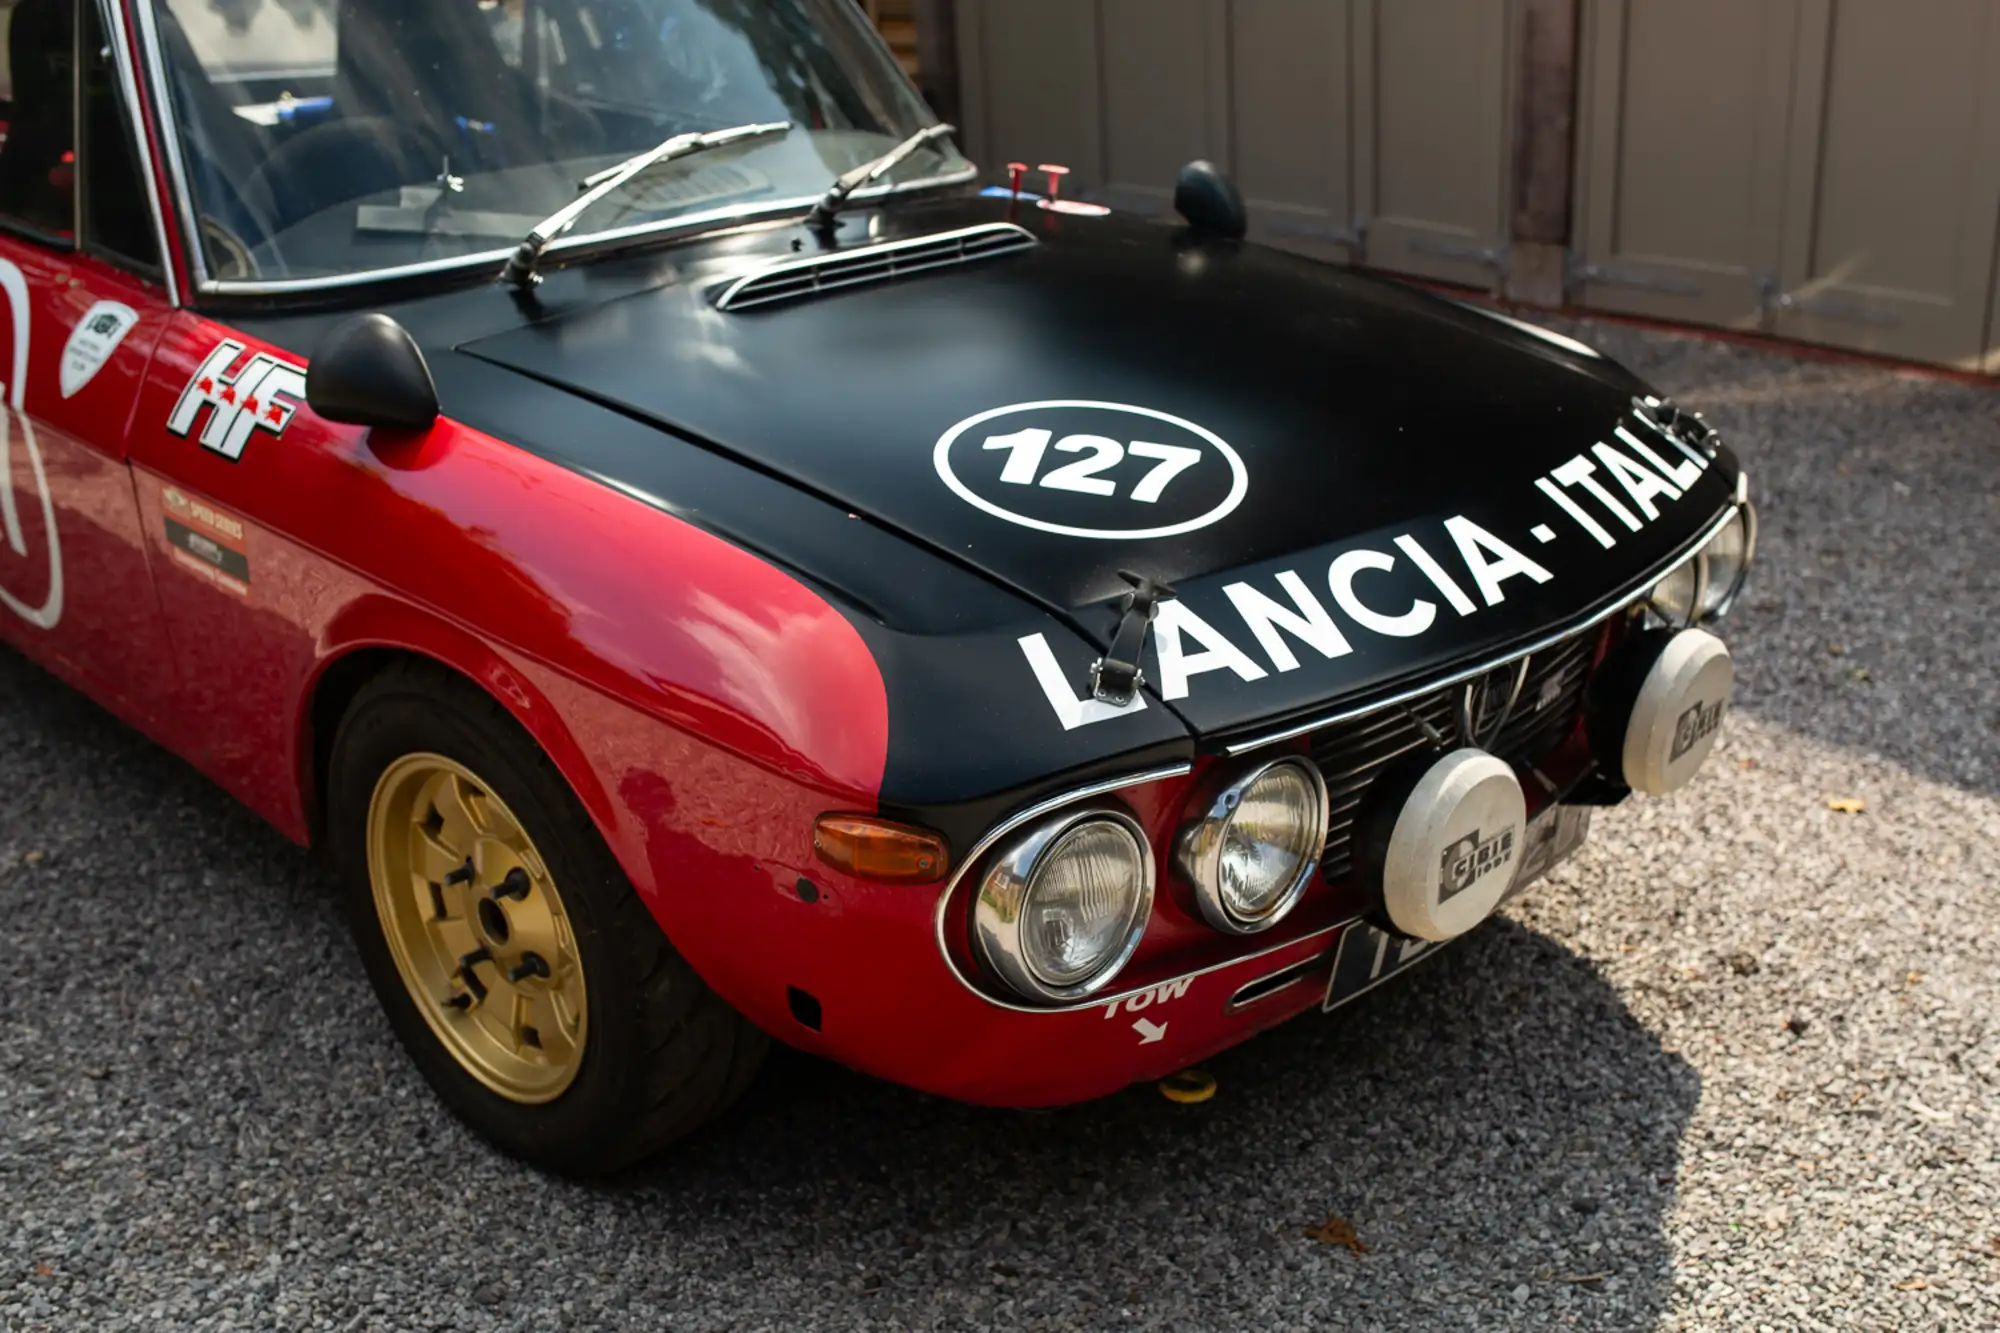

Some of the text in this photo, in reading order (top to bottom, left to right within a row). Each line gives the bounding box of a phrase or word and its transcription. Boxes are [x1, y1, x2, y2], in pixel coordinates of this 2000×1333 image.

[165, 337, 308, 463] HF
[982, 427, 1202, 503] 127
[1018, 515, 1553, 731] LANCIA
[1102, 976, 1196, 1020] TOW
